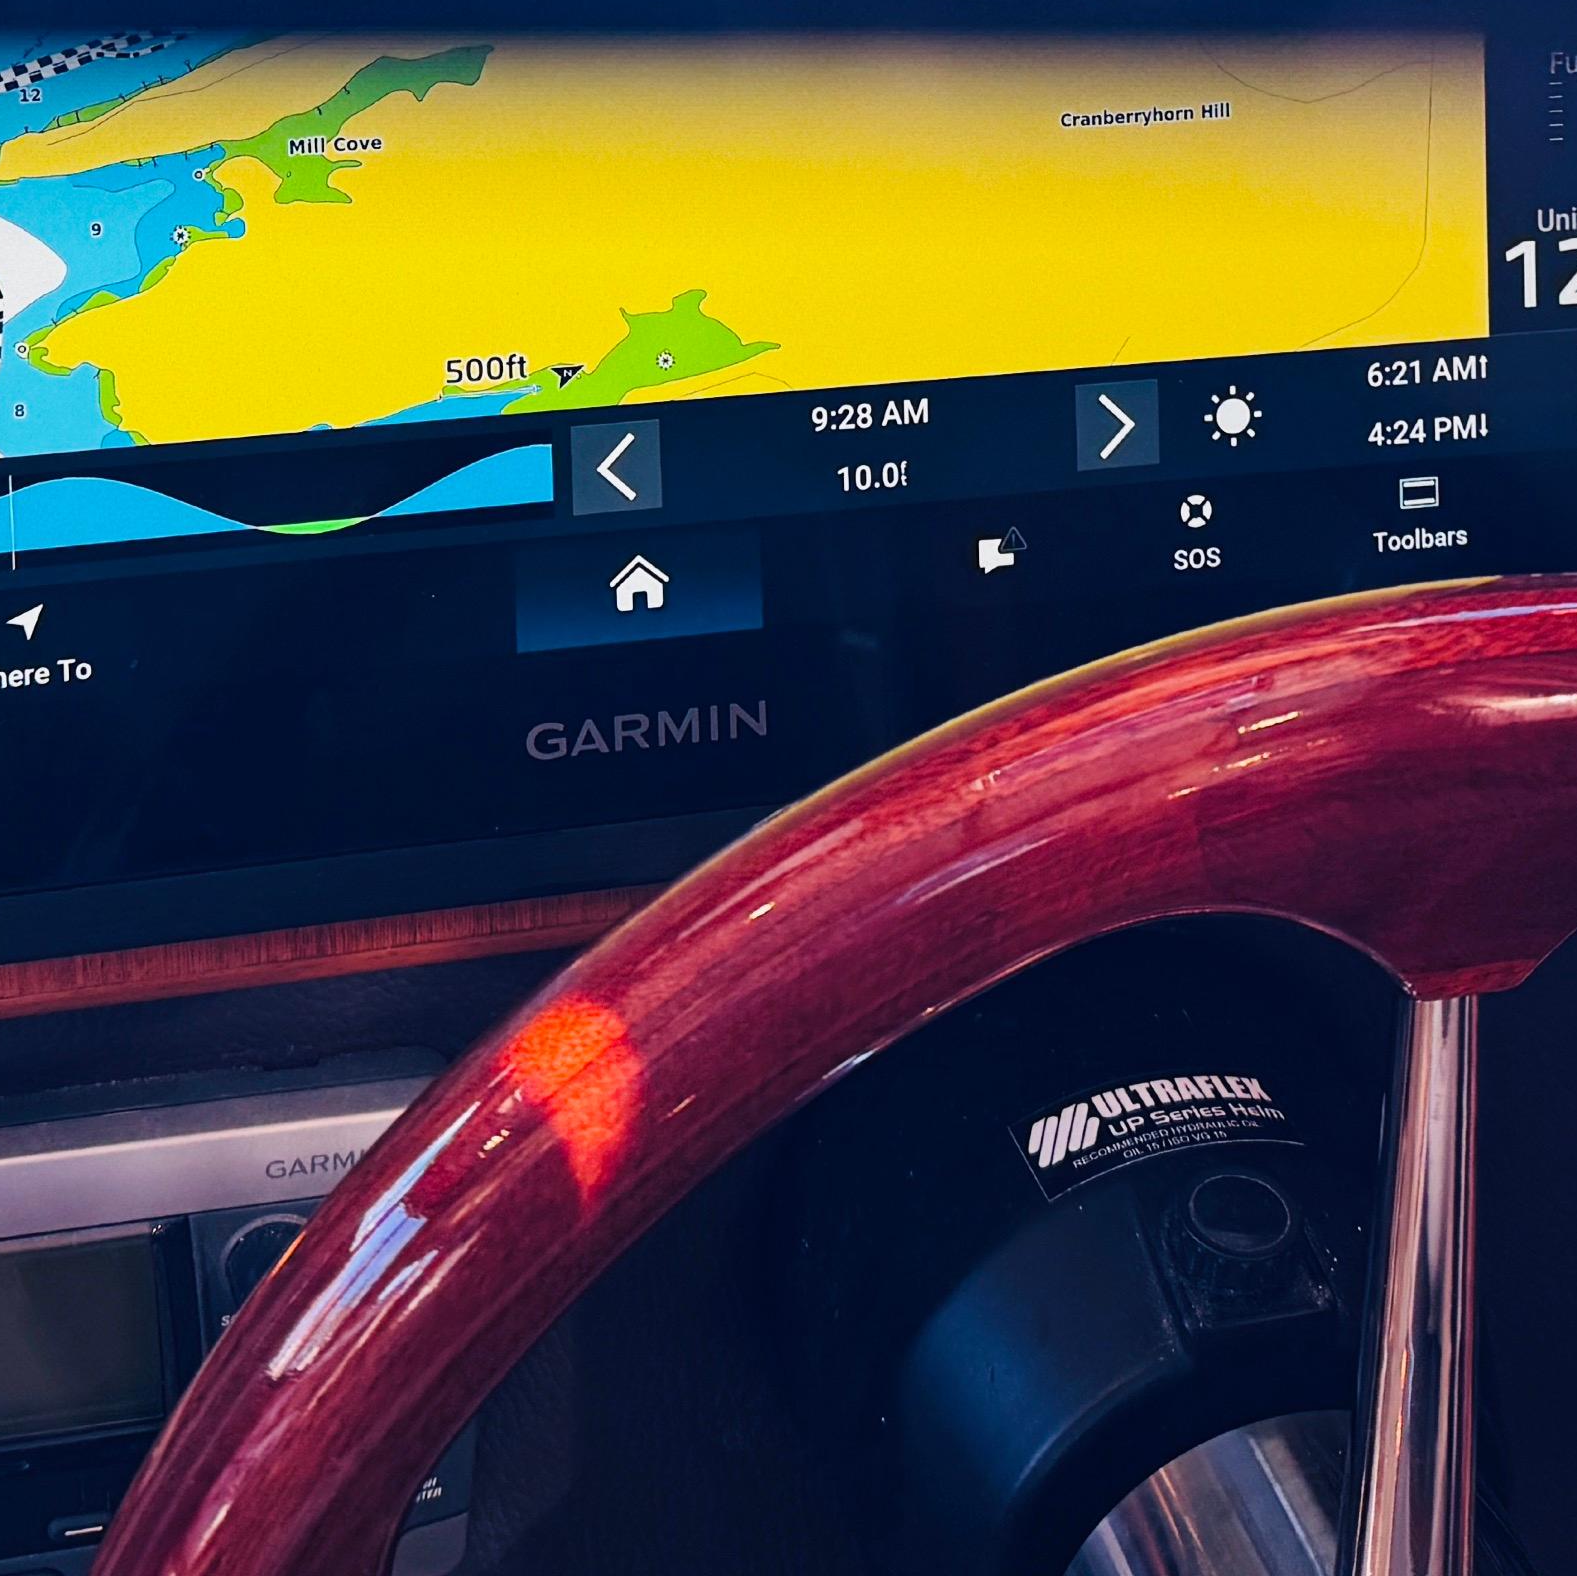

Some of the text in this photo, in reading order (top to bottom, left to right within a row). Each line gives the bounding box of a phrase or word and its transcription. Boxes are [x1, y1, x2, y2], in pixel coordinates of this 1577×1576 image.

[19, 88, 42, 103] 12
[1060, 102, 1231, 128] Cranberryhorn Hill
[288, 137, 383, 155] Mill Cove
[90, 223, 102, 238] 9
[446, 354, 528, 384] 500ft
[1367, 355, 1478, 388] 6:21 AM
[14, 404, 25, 418] 8
[811, 397, 930, 432] 9:28 AM
[1367, 414, 1477, 447] 4:24 PM
[1373, 527, 1468, 554] Toolbars
[1173, 547, 1222, 571] SOS
[56, 658, 92, 682] To
[526, 699, 768, 761] GARMIN
[1090, 1075, 1273, 1118] ULTRAFLEX
[1108, 1102, 1285, 1137] UP Series Helm
[1072, 1127, 1169, 1169] RECOMMENDED
